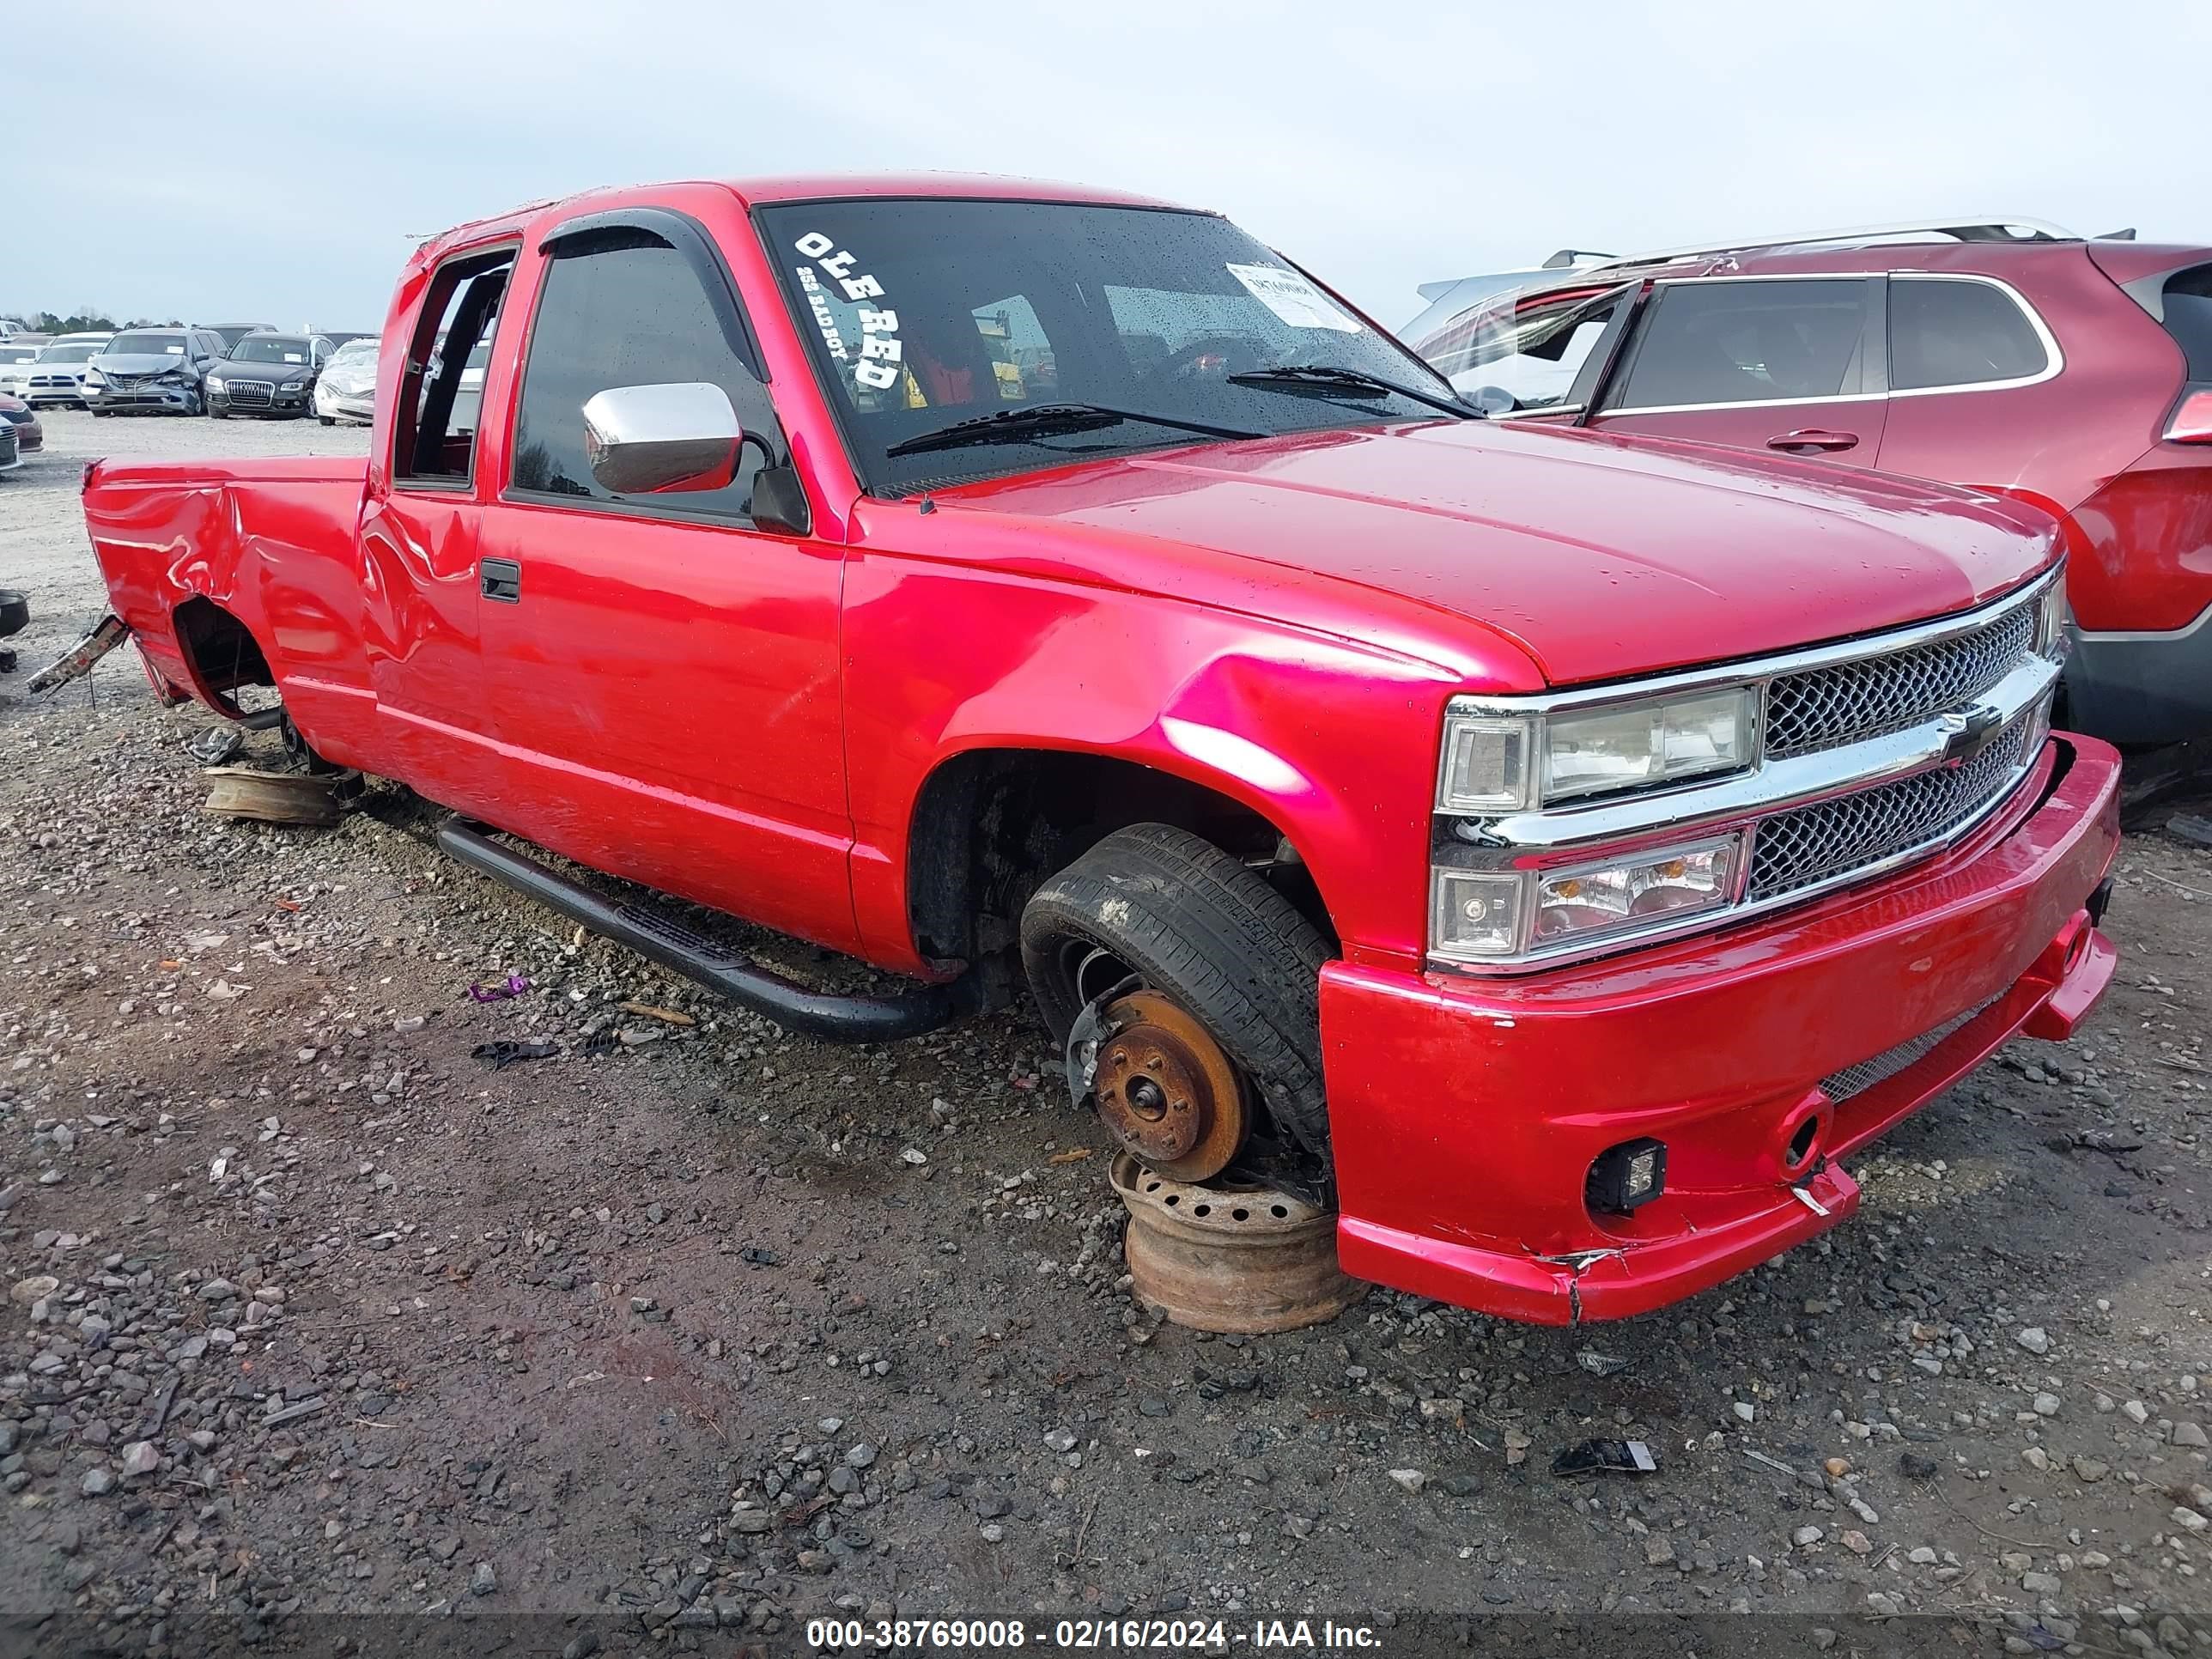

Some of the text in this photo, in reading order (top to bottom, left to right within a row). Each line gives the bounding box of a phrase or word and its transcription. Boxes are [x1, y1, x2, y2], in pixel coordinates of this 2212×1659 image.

[794, 232, 902, 389] OLE RED
[796, 266, 820, 292] 252
